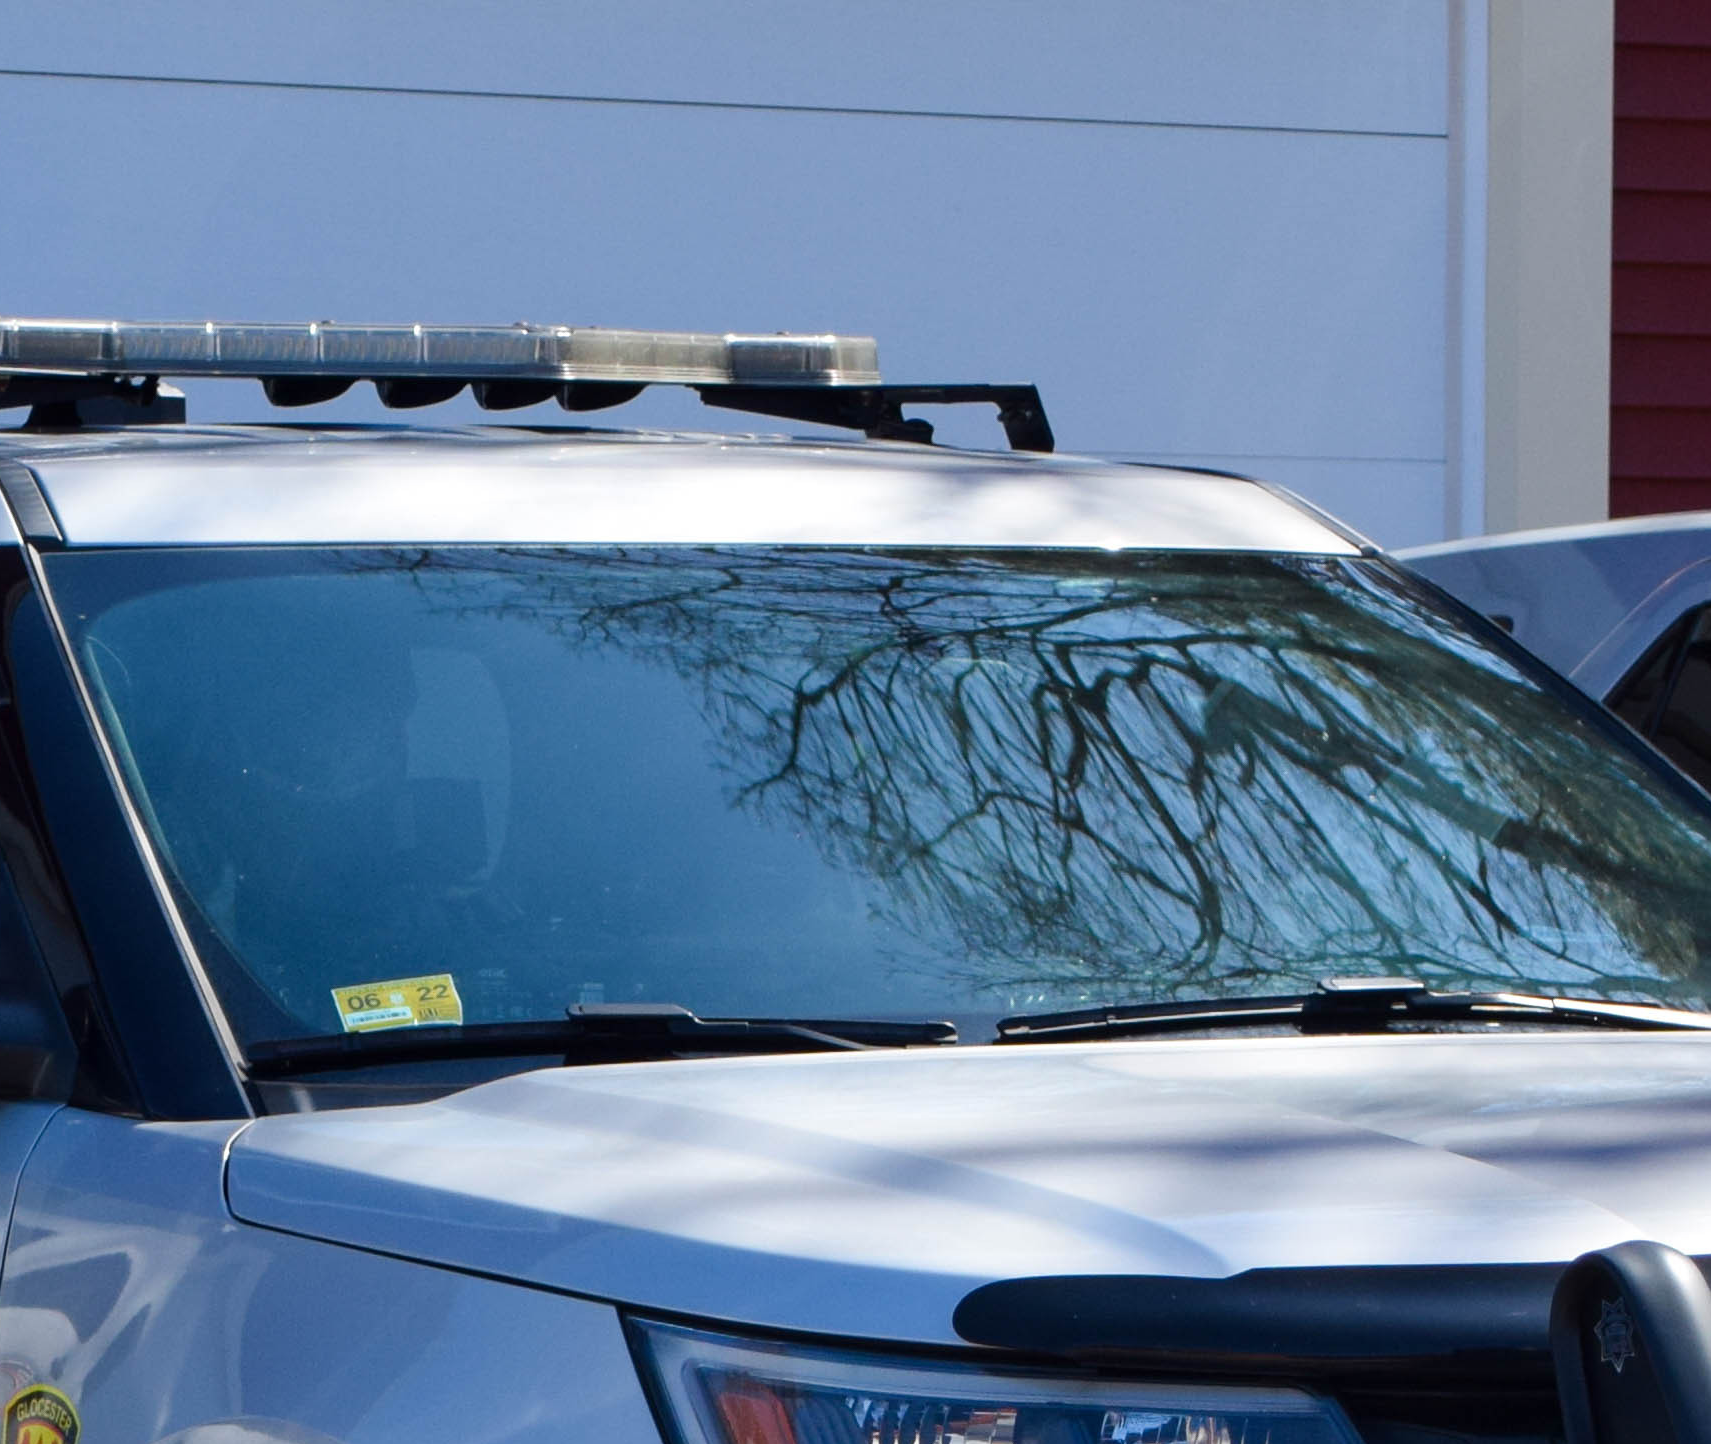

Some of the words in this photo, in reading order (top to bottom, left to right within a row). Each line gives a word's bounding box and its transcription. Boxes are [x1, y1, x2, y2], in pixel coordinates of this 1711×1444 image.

[347, 993, 381, 1010] 06
[417, 984, 449, 1001] 22
[16, 1399, 73, 1434] GLOCESTER
